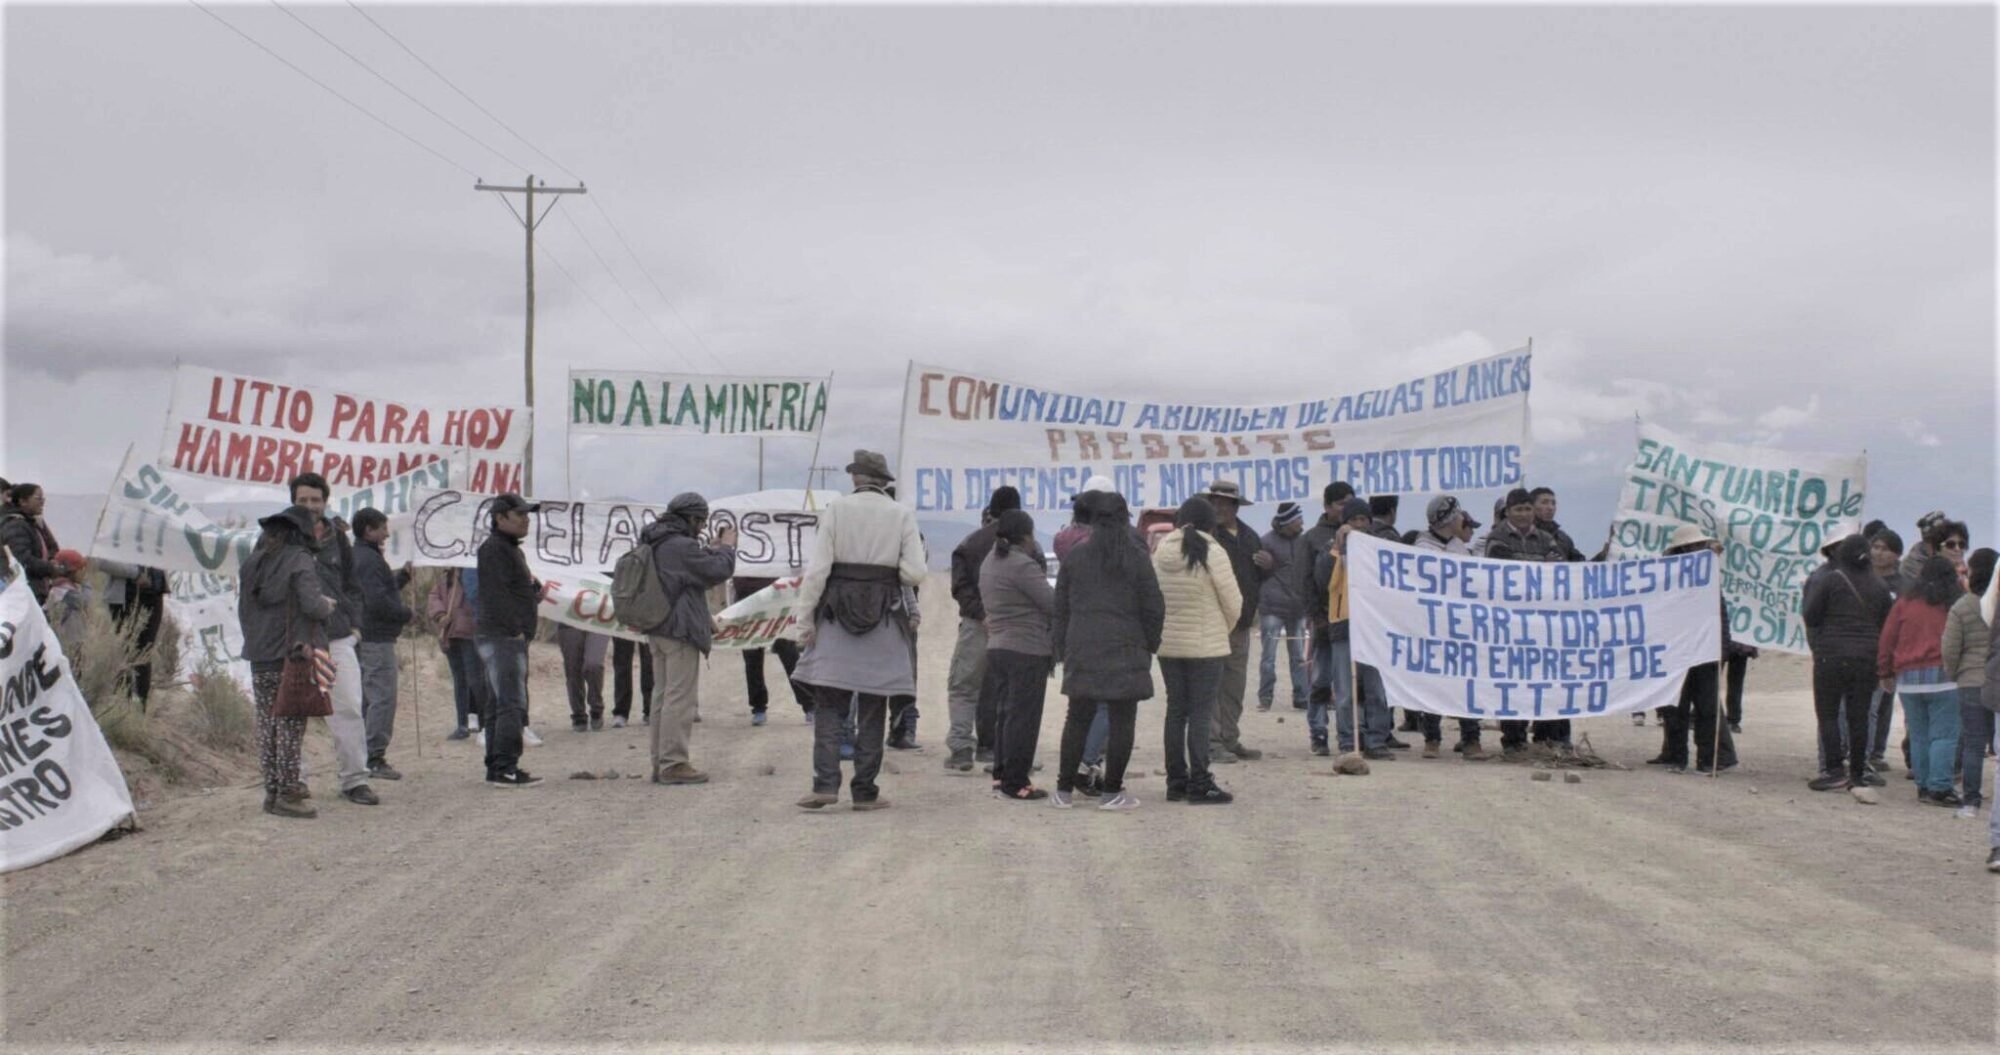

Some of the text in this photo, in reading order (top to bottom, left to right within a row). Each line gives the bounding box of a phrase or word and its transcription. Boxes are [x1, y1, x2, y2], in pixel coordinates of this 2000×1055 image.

[208, 376, 515, 449] LITIO PARA HOY
[573, 379, 828, 434] NO A LA MINERIA
[919, 373, 1126, 427] COMUNIDAD
[1331, 378, 1426, 423] AGUAS
[1433, 355, 1532, 409] BLANCAS
[172, 422, 324, 486] HAMBRE
[915, 468, 954, 511] EN
[1114, 464, 1146, 507] DE
[1322, 445, 1521, 494] TERRITORIOS
[1631, 476, 1717, 535] TRES
[1378, 549, 1714, 601] RESPETEN A NUESTRO
[1418, 598, 1646, 648] TERRITORIO
[1387, 632, 1668, 681] FUERA EMPRESA DE
[1466, 679, 1608, 716] LITIO
